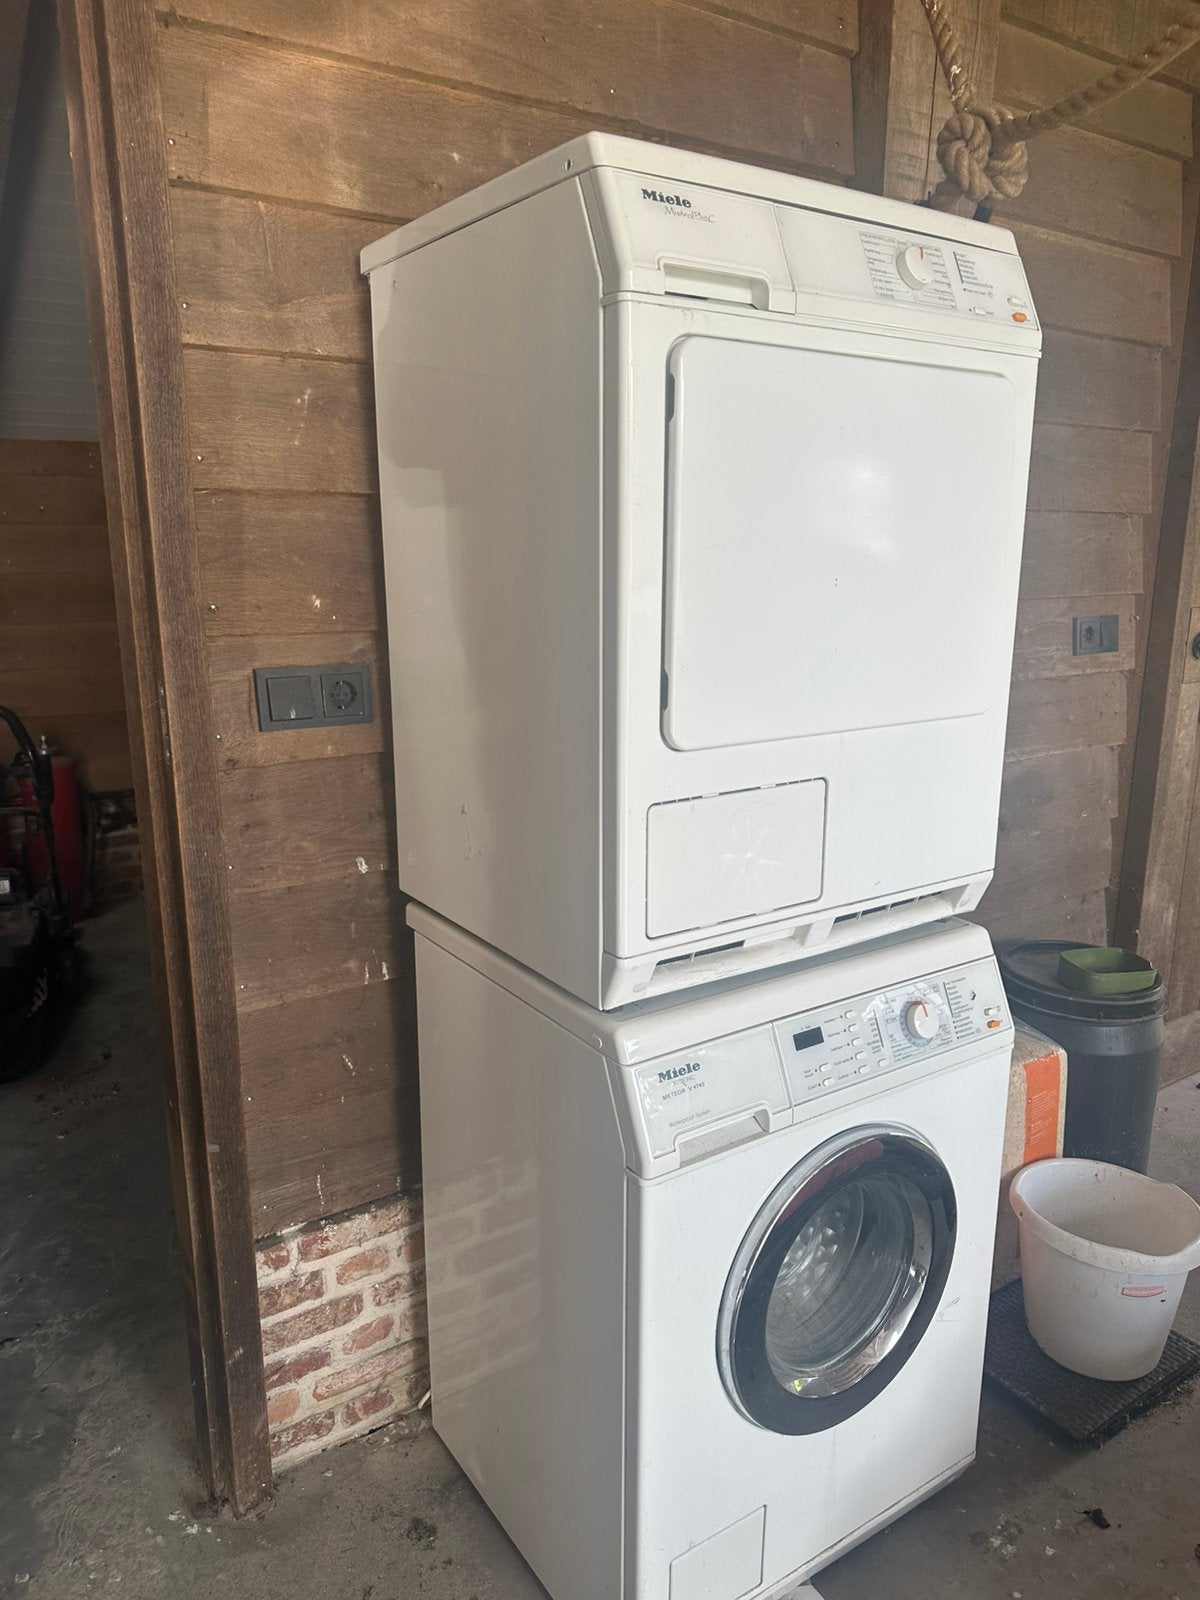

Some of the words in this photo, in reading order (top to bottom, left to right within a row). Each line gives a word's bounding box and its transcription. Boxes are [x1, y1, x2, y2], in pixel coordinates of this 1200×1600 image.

[641, 188, 692, 208] Miele
[658, 1062, 700, 1083] Miele
[662, 1088, 686, 1100] METEOR
